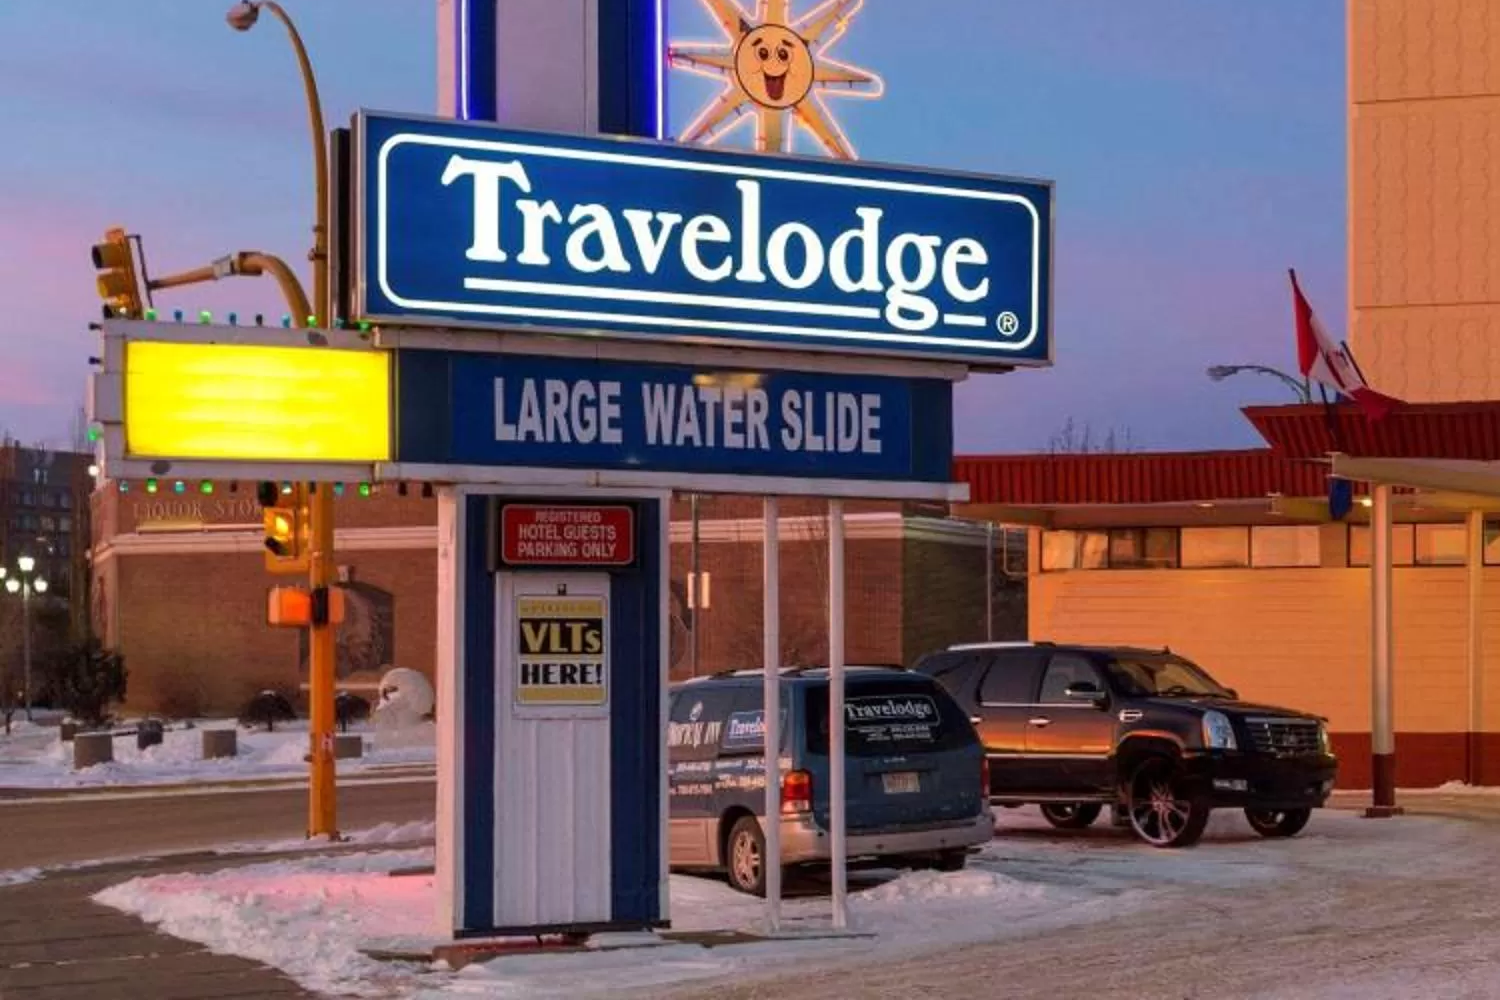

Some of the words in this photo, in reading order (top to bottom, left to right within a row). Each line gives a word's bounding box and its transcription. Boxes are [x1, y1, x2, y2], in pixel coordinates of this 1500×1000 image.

[440, 155, 990, 331] Travelodge
[493, 376, 623, 444] LARGE
[641, 382, 771, 450] WATER
[781, 390, 883, 455] SLIDE
[518, 523, 561, 541] HOTEL
[563, 524, 617, 541] GUESTS
[517, 541, 578, 558] PARKING
[581, 542, 617, 558] ONLY
[520, 621, 602, 653] VLTs
[520, 662, 603, 685] HERE!
[843, 699, 933, 719] Travelodge
